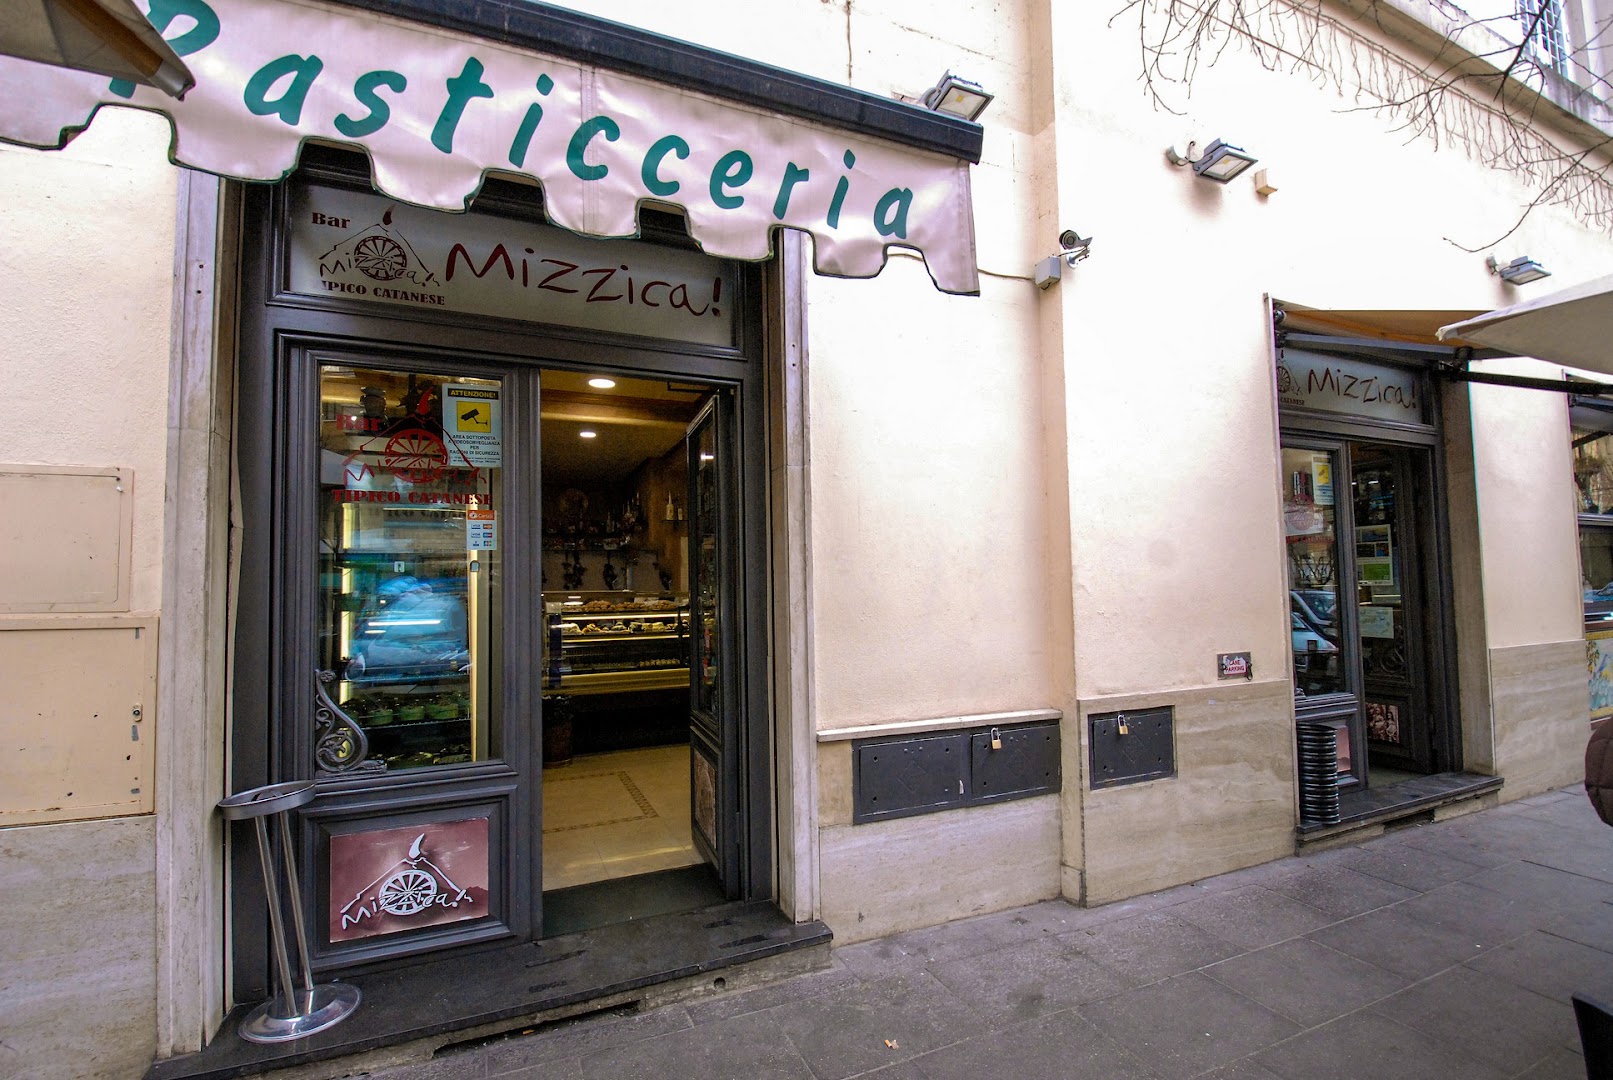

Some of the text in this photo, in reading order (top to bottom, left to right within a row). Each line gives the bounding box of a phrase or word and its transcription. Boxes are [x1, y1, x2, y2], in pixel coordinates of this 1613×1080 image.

[311, 212, 350, 228] Bar
[446, 243, 721, 318] Mizzica!
[373, 286, 445, 306] CATANESE
[450, 389, 497, 398] ATTENZIONE!
[1307, 367, 1417, 409] Mizzica!
[336, 414, 383, 431] Bar
[331, 489, 491, 505] TIPICO CATANESE
[341, 886, 467, 930] Mizzica!
